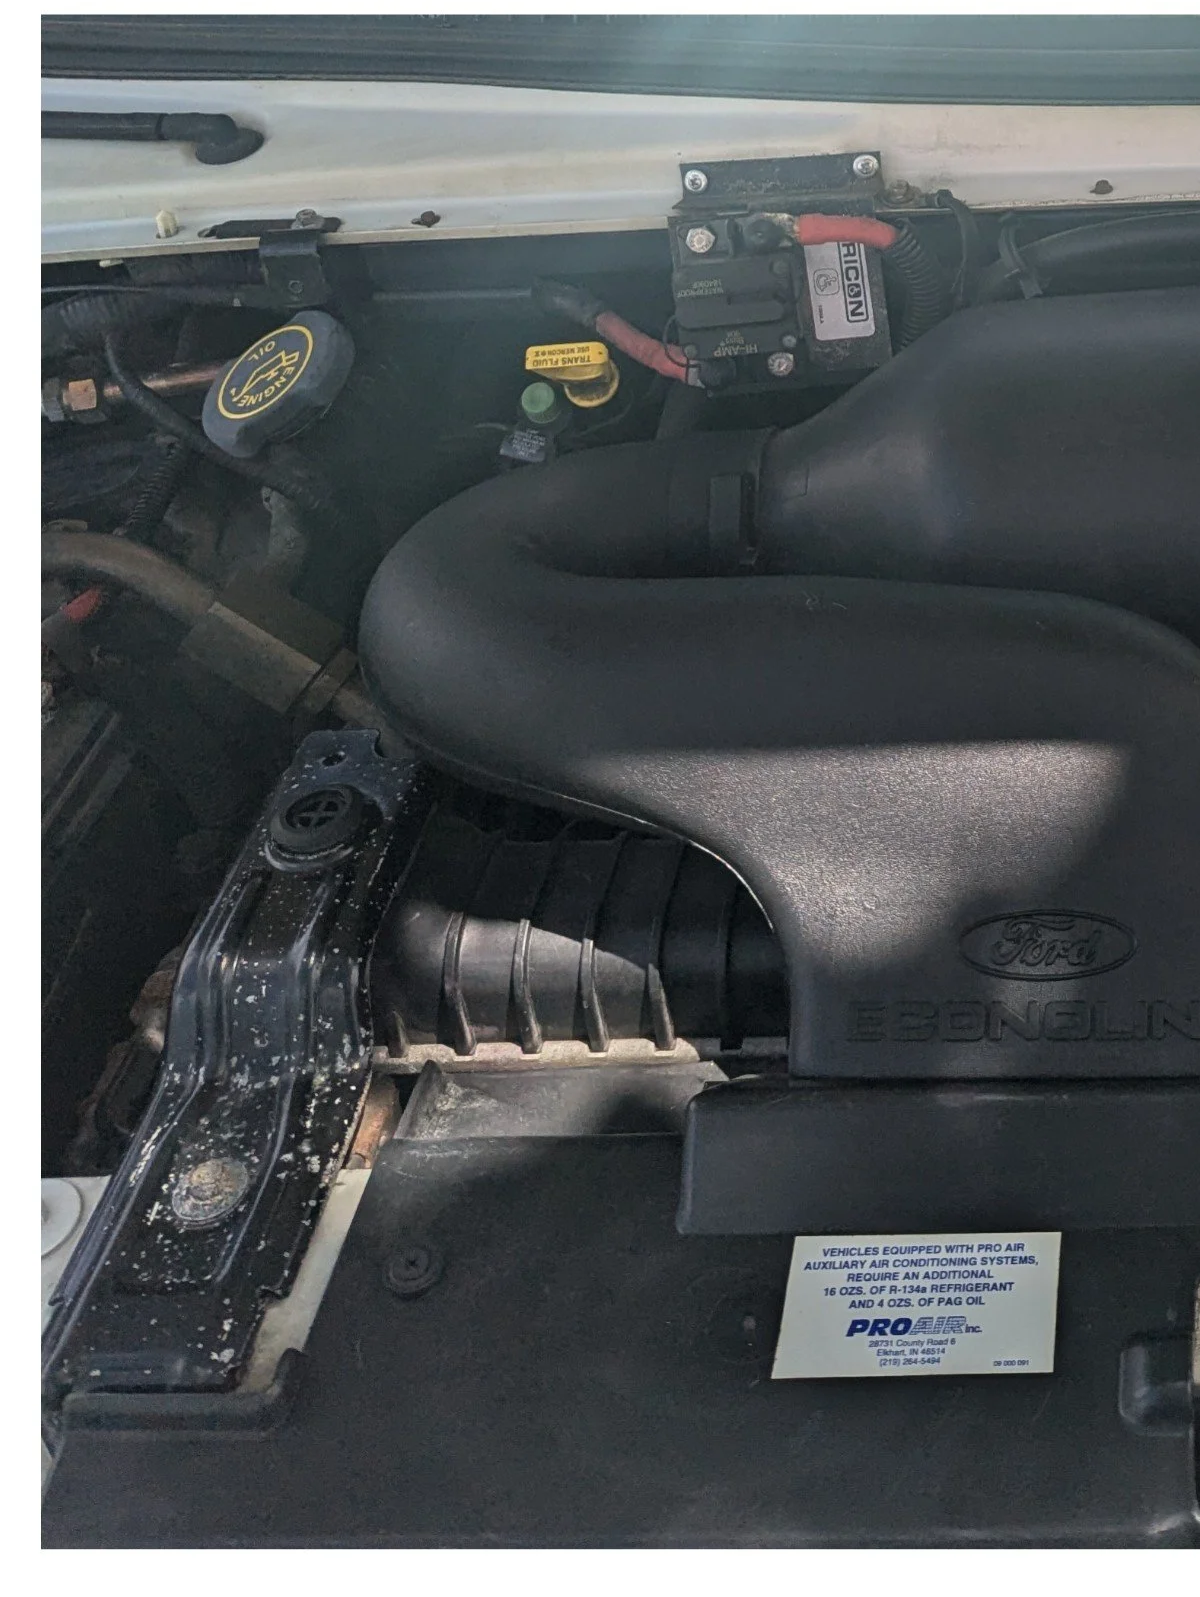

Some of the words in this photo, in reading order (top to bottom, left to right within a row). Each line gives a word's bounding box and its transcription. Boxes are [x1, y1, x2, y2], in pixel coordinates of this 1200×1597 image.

[841, 242, 865, 318] RICON
[676, 286, 725, 299] WATERPROOF
[247, 340, 276, 361] OIL
[713, 343, 759, 358] HI-AMP
[532, 357, 558, 368] FLUID
[562, 354, 593, 365] TRANS
[236, 366, 296, 407] ENGINE
[991, 916, 1100, 968] Ford
[821, 1247, 880, 1257] VEHICLES
[881, 1245, 941, 1257] EQUIPPED
[943, 1243, 975, 1255] WITH
[976, 1243, 1003, 1254] PRO
[1004, 1242, 1025, 1253] AIR
[803, 1259, 868, 1271] AUXILIARY
[869, 1257, 890, 1269] AIR
[891, 1256, 978, 1269] CONDITIONING
[979, 1255, 1039, 1267] SYSTEMS,
[846, 1271, 900, 1283] REQUIRE
[901, 1271, 921, 1281] AN
[921, 1269, 994, 1281] ADDITIONAL
[823, 1286, 837, 1297] 16
[839, 1285, 868, 1297] OZS.
[869, 1285, 887, 1295] OF
[888, 1283, 928, 1295] R-134a
[929, 1281, 1015, 1294] REFRIGERANT
[848, 1299, 875, 1309] AND
[877, 1298, 885, 1309] 4
[886, 1297, 915, 1309] OZS.
[917, 1297, 935, 1307] OF
[936, 1296, 963, 1307] PAG
[965, 1295, 986, 1306] OIL
[867, 1338, 894, 1349] 28731
[895, 1337, 925, 1350] County
[926, 1337, 949, 1347] Road
[950, 1337, 957, 1346] 6
[876, 1348, 907, 1358] Elkhart,
[908, 1347, 919, 1357] IN
[879, 1357, 901, 1368] (219)
[901, 1356, 941, 1366] 264-5494
